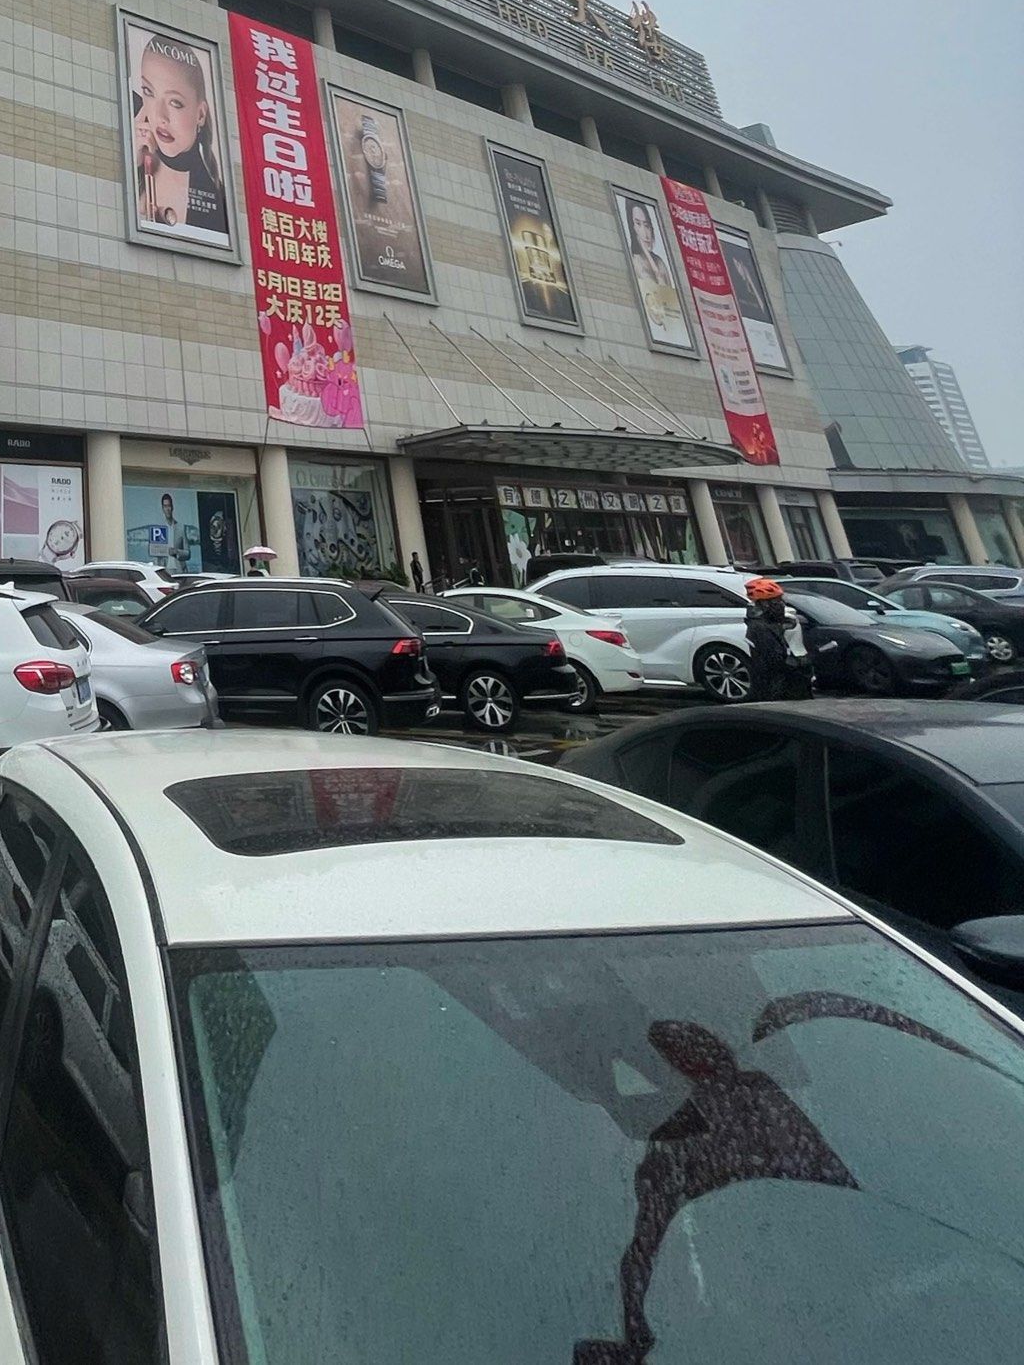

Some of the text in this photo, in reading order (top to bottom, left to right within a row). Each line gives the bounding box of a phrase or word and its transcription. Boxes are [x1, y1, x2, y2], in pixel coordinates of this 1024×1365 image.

[249, 27, 316, 208] 我过生日啦
[261, 206, 328, 243] 德百大楼
[378, 255, 406, 271] OMEGA
[257, 268, 343, 303] 5月1日至12日
[265, 294, 343, 330] 大庆12天
[7, 438, 31, 448] RADO
